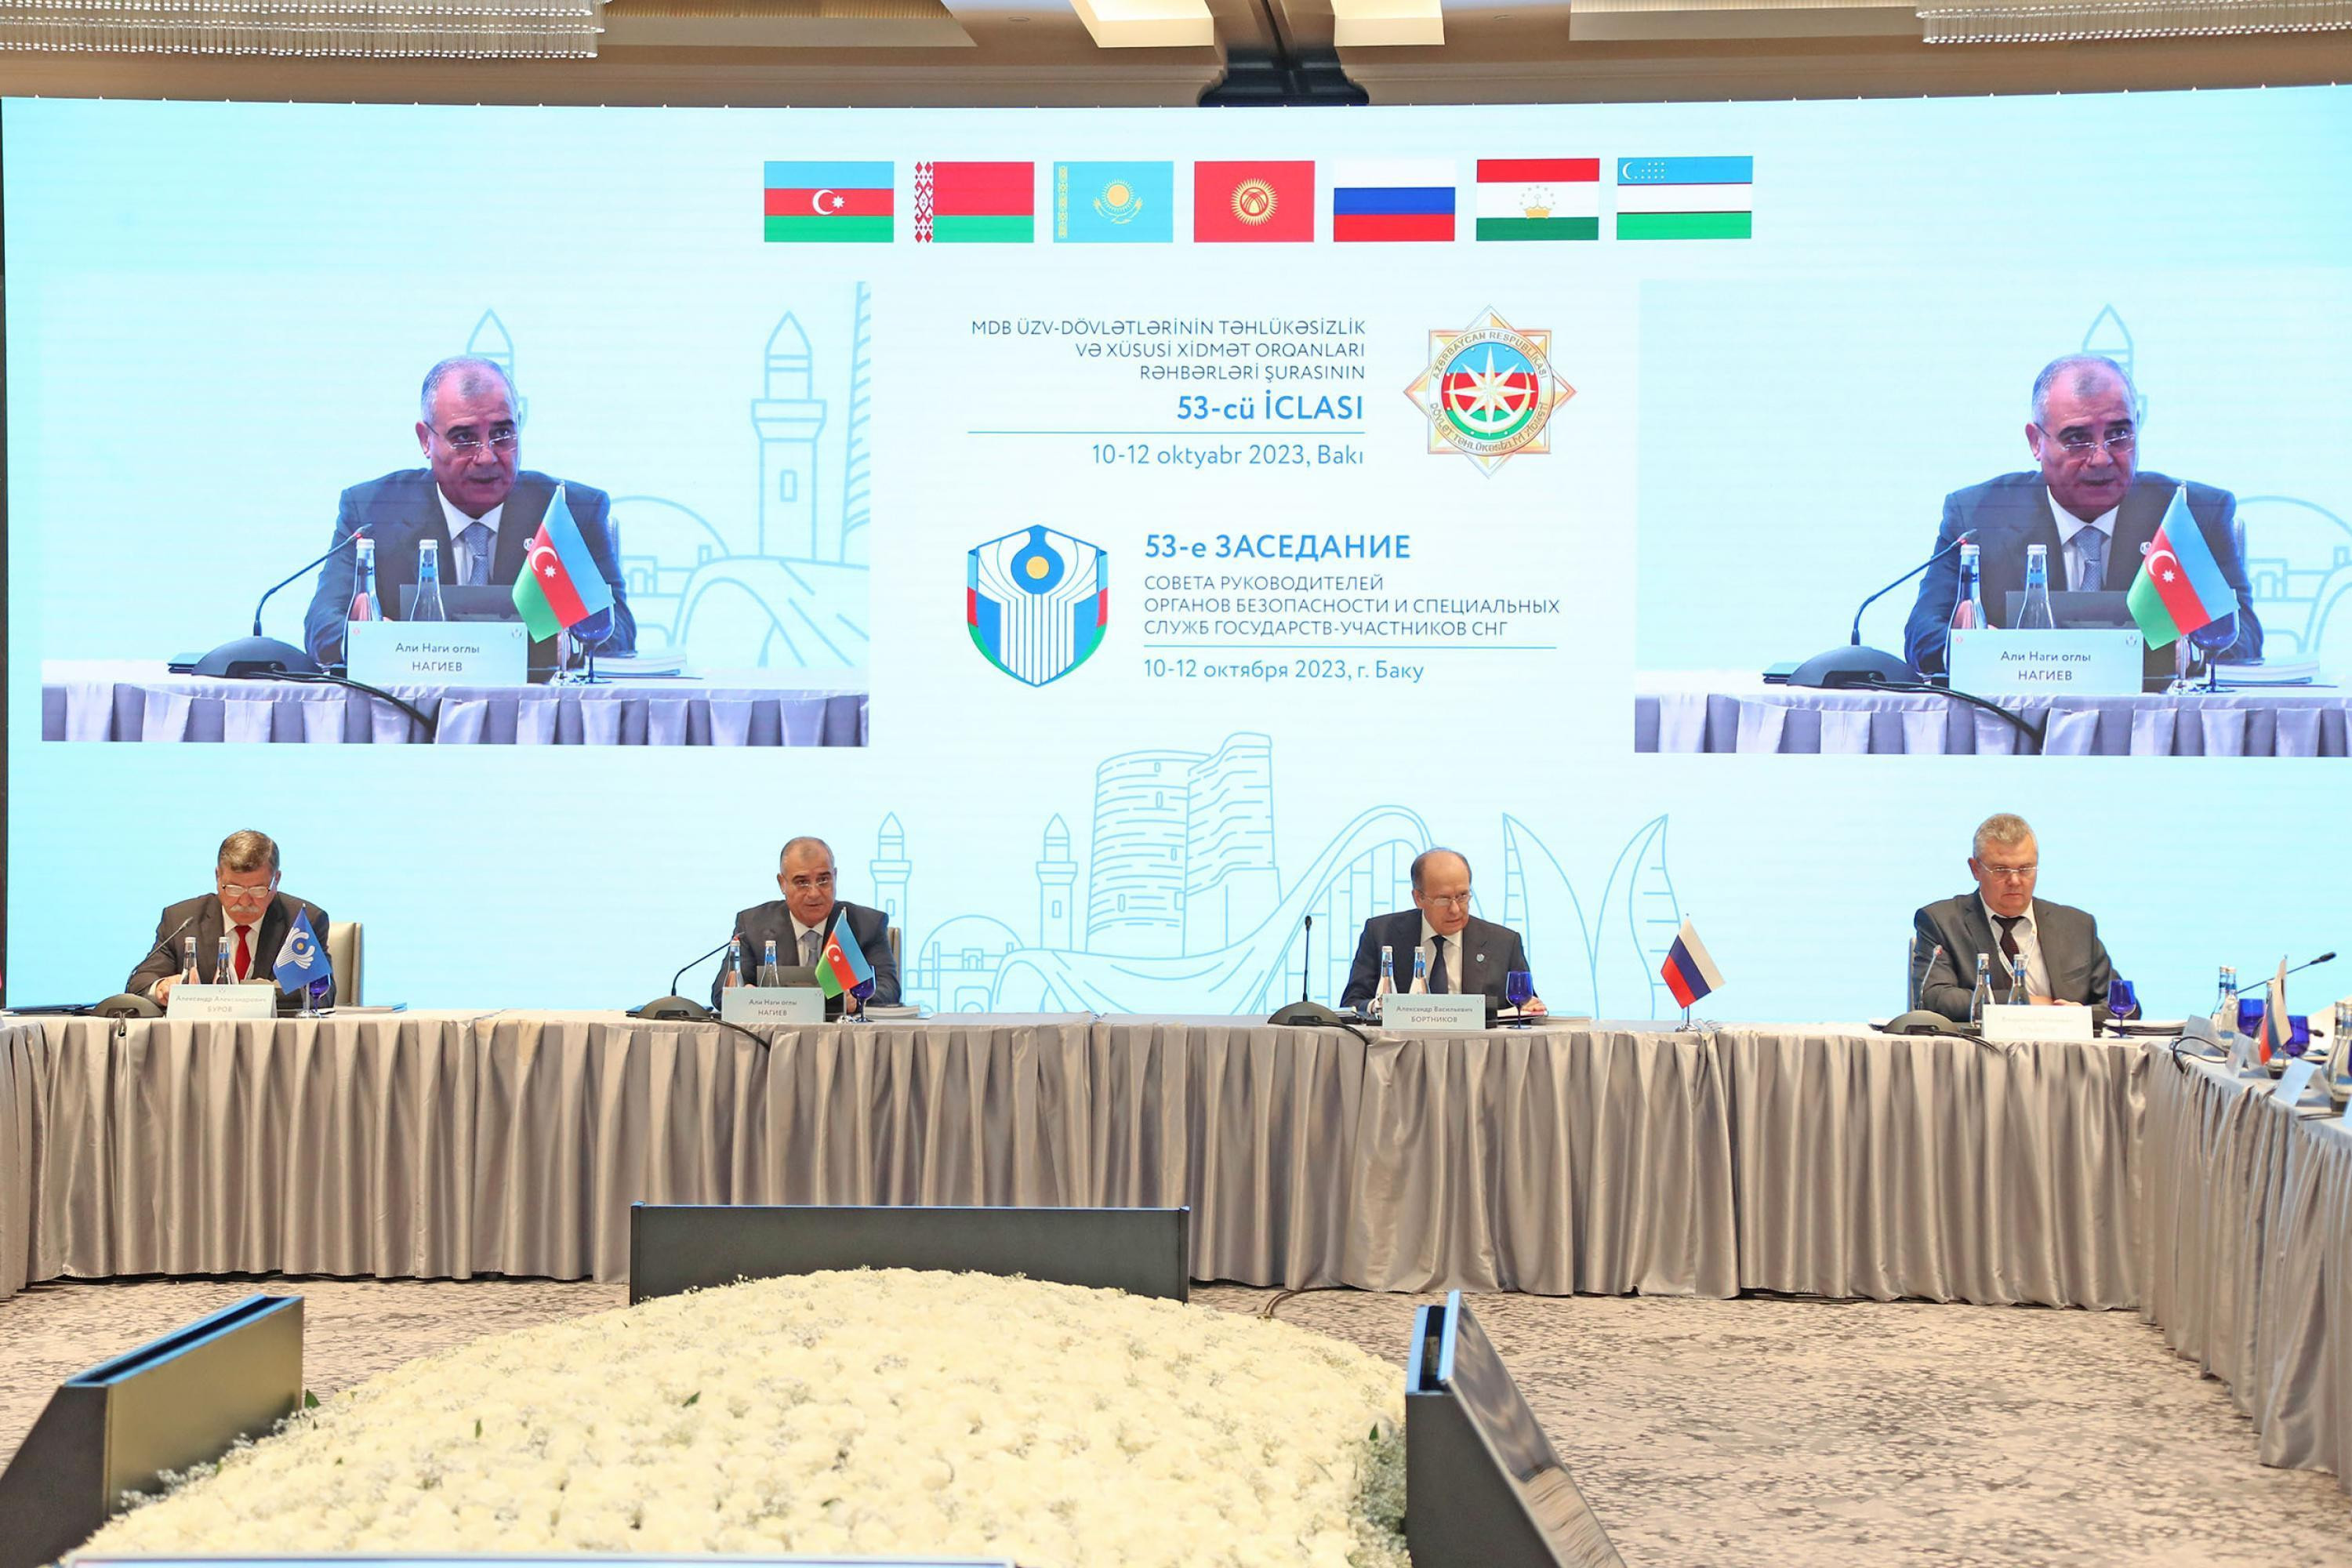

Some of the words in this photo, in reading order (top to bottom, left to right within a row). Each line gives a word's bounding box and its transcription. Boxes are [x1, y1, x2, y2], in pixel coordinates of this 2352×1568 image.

[971, 320, 1011, 335] MDB
[1017, 318, 1214, 335] ÜZV-DÖVLƏTLƏRİNİN
[1218, 317, 1366, 335] TƏHLÜKƏSİZLİK
[1076, 343, 1102, 358] VƏ
[1106, 339, 1171, 358] XÜSUSİ
[1178, 340, 1250, 358] XİDMƏT
[1256, 343, 1364, 358] ORQANLARI
[1141, 362, 1259, 380] RƏHBƏRLƏRİ
[1265, 365, 1365, 383] ŞURASININ
[1177, 395, 1254, 421] 53-cü
[1265, 390, 1363, 420] İCLASI
[1091, 444, 1150, 464] 10-12
[1156, 443, 1243, 470] oktyabr
[1248, 445, 1311, 468] 2023,
[1318, 444, 1364, 464] Bakı
[1145, 535, 1207, 558] 53-е
[1214, 534, 1411, 561] ЗАСЕДАНИЕ
[1144, 575, 1216, 590] СОВЕТА
[1221, 573, 1384, 593] РУКОВОДИТЕЛЕЙ
[1144, 597, 1232, 613] ОРГАНОВ
[1236, 598, 1389, 614] БЕЗОПАСНОСТИ
[1395, 599, 1408, 613] И
[1413, 599, 1561, 617] СПЕЦИАЛЬНЫХ
[1144, 620, 1210, 635] СЛУЖБ
[1214, 621, 1468, 639] ГОСУДАРСТВ-УЧАСТНИКОВ
[1472, 622, 1508, 636] СНГ
[395, 643, 419, 652] Али
[423, 643, 449, 652] Наги
[2001, 651, 2026, 661] Али
[2030, 652, 2058, 661] Наги
[412, 662, 463, 672] НАГИЕВ
[1145, 659, 1198, 678] 10-12
[1203, 659, 1289, 684] октября
[1294, 660, 1352, 682] 2023,
[1359, 664, 1370, 678] г.
[1377, 660, 1425, 684] Баку
[2018, 670, 2072, 681] НАГИЕВ
[1396, 1005, 1432, 1014] Александр
[1411, 1015, 1458, 1024] БОРТНИКОВ
